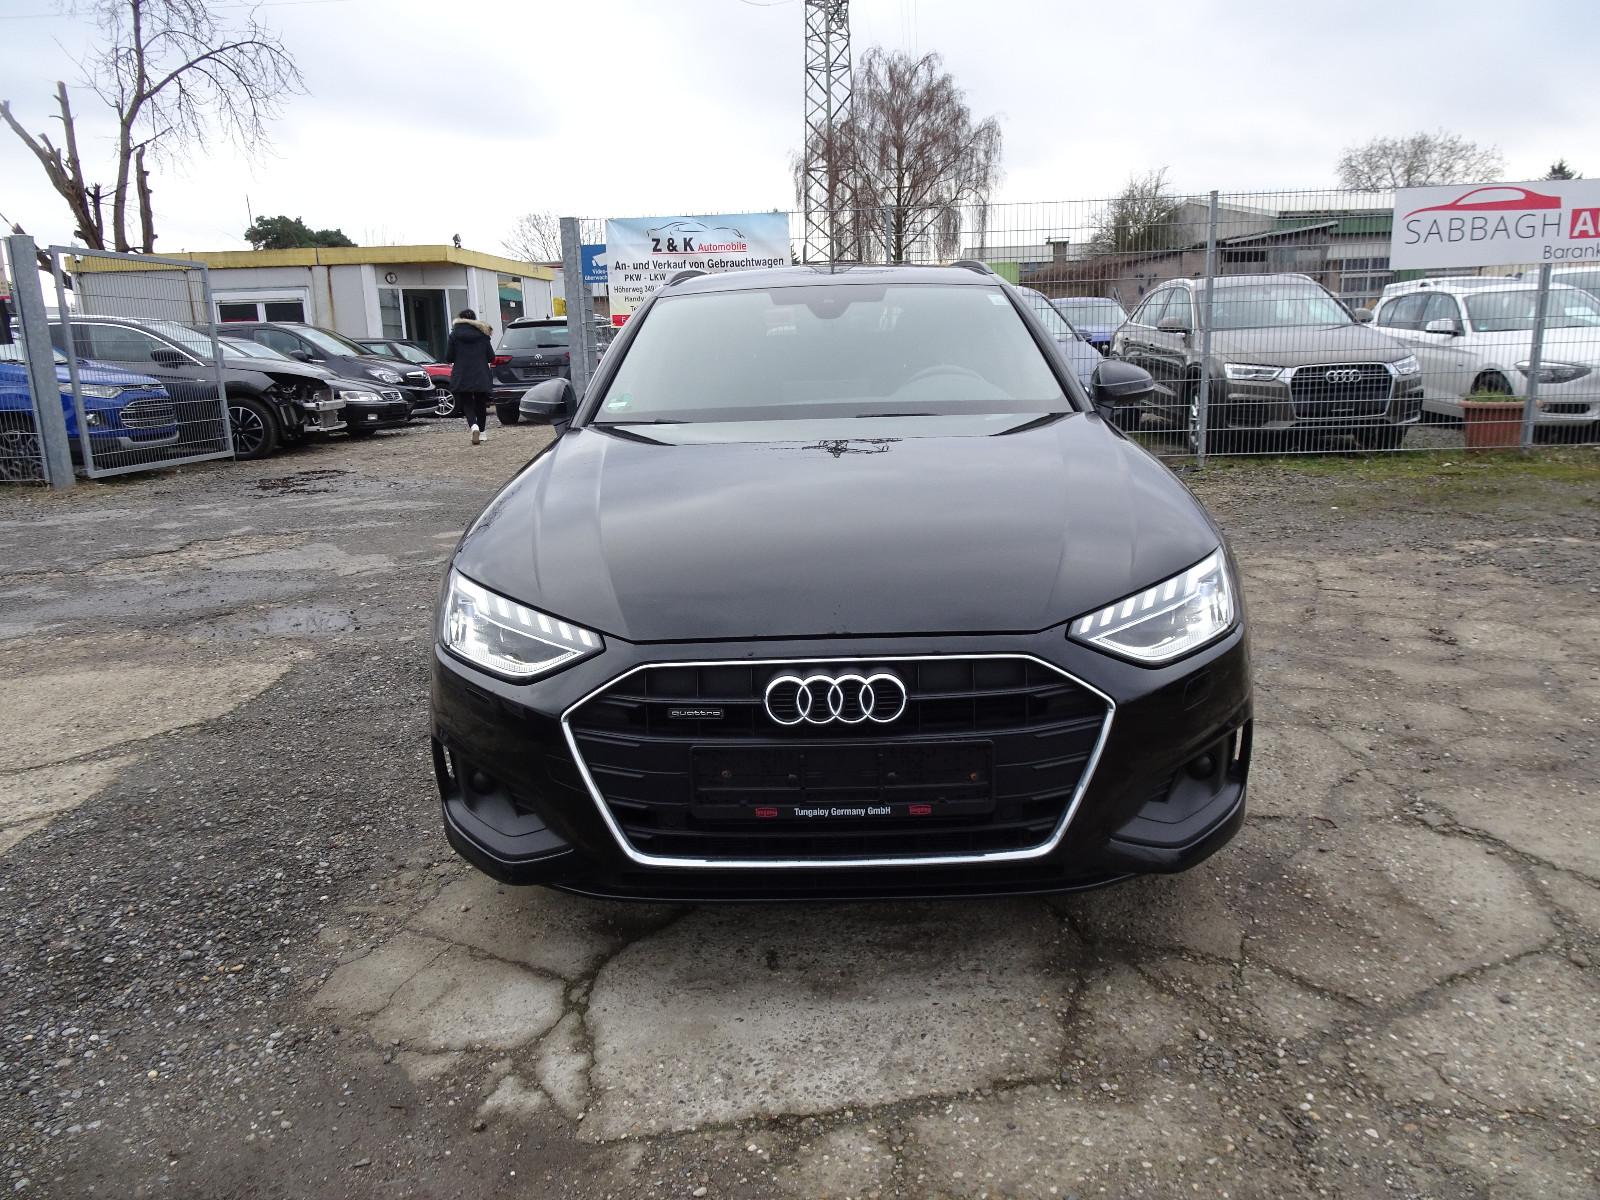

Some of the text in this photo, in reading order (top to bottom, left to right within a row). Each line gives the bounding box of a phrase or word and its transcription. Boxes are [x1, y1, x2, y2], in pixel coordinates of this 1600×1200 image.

[1404, 210, 1600, 244] SABBAGH A
[652, 237, 747, 252] Z & K Automobile
[614, 260, 630, 270] An-
[633, 260, 649, 270] und
[652, 260, 686, 269] Verkauf
[708, 257, 784, 268] Gebrauchtwagen
[624, 274, 642, 282] PKW
[794, 806, 891, 818] Tungaloy Germany GmbH
